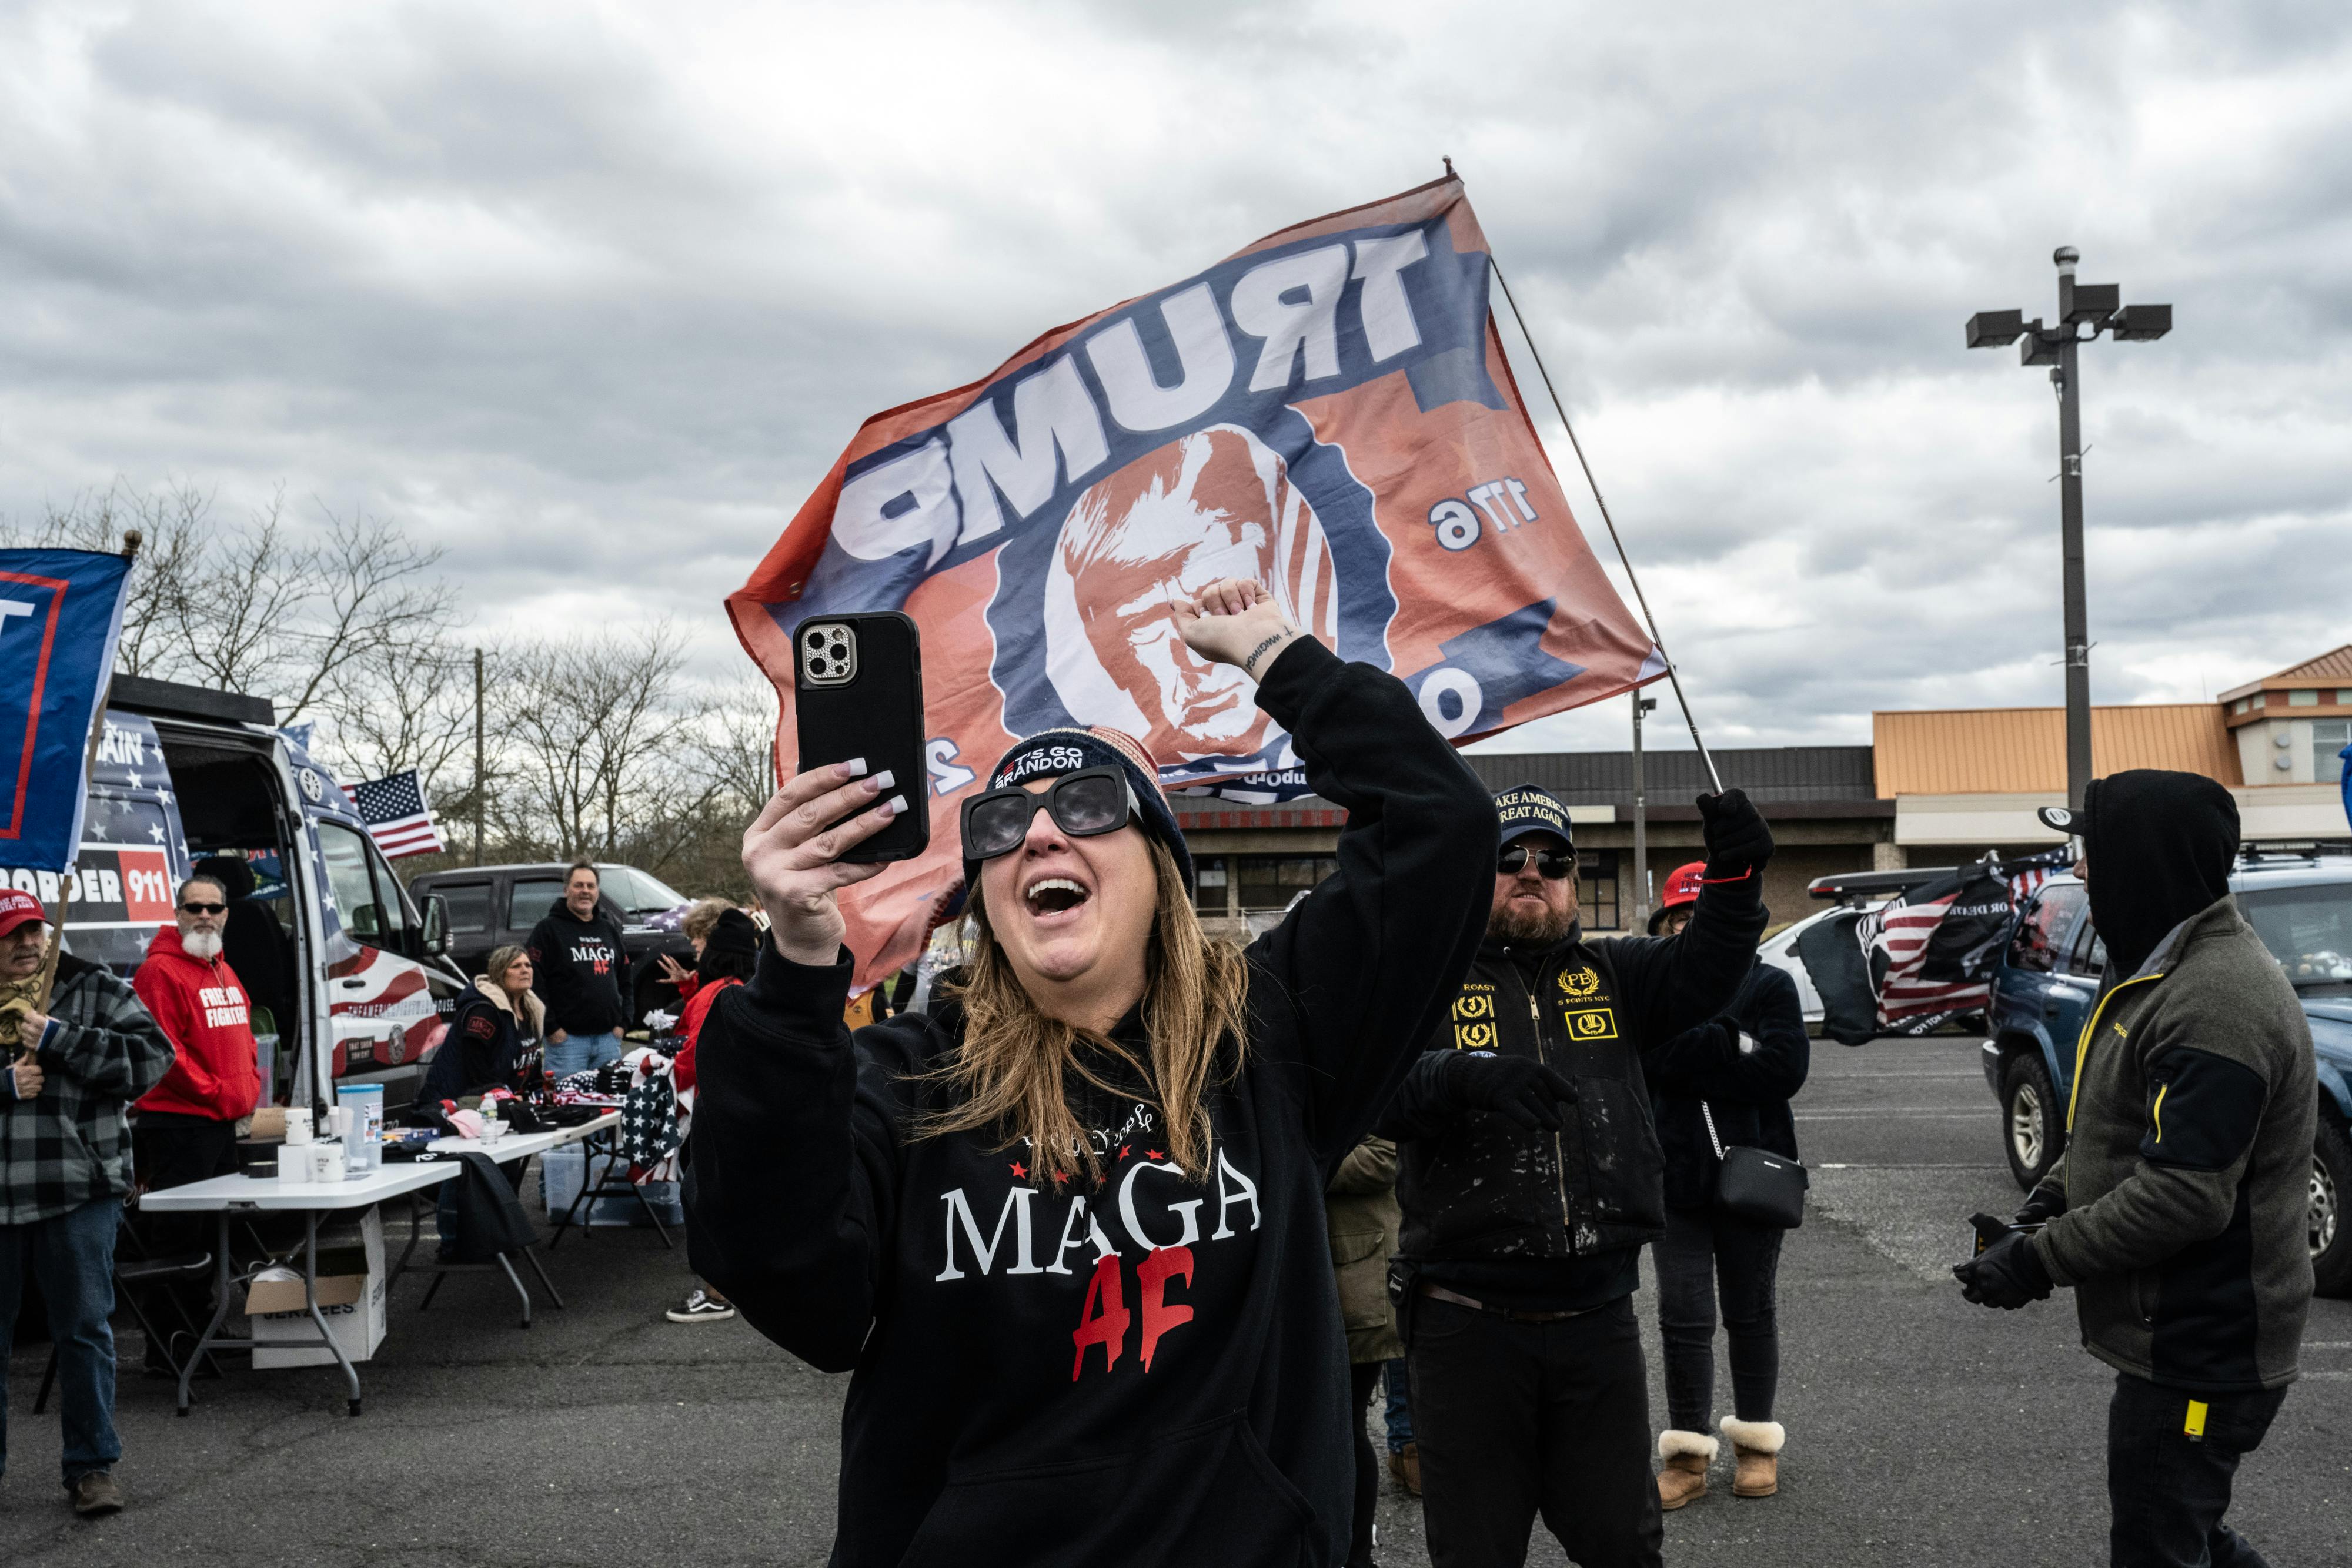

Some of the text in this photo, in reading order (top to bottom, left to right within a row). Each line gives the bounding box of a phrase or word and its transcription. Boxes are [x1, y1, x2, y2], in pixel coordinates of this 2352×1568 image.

[1050, 746, 1083, 757] GO
[995, 757, 1082, 790] BRANDON
[1496, 791, 1569, 818] AKE AMERICA
[1499, 806, 1563, 830] REAT AGAIN
[128, 868, 167, 903] 911
[570, 947, 615, 964] MAGA
[594, 959, 610, 976] AF
[1463, 984, 1496, 992] ROAST
[1566, 973, 1592, 987] PB
[935, 1146, 1261, 1282] MAGA
[1072, 1245, 1195, 1382] AF
